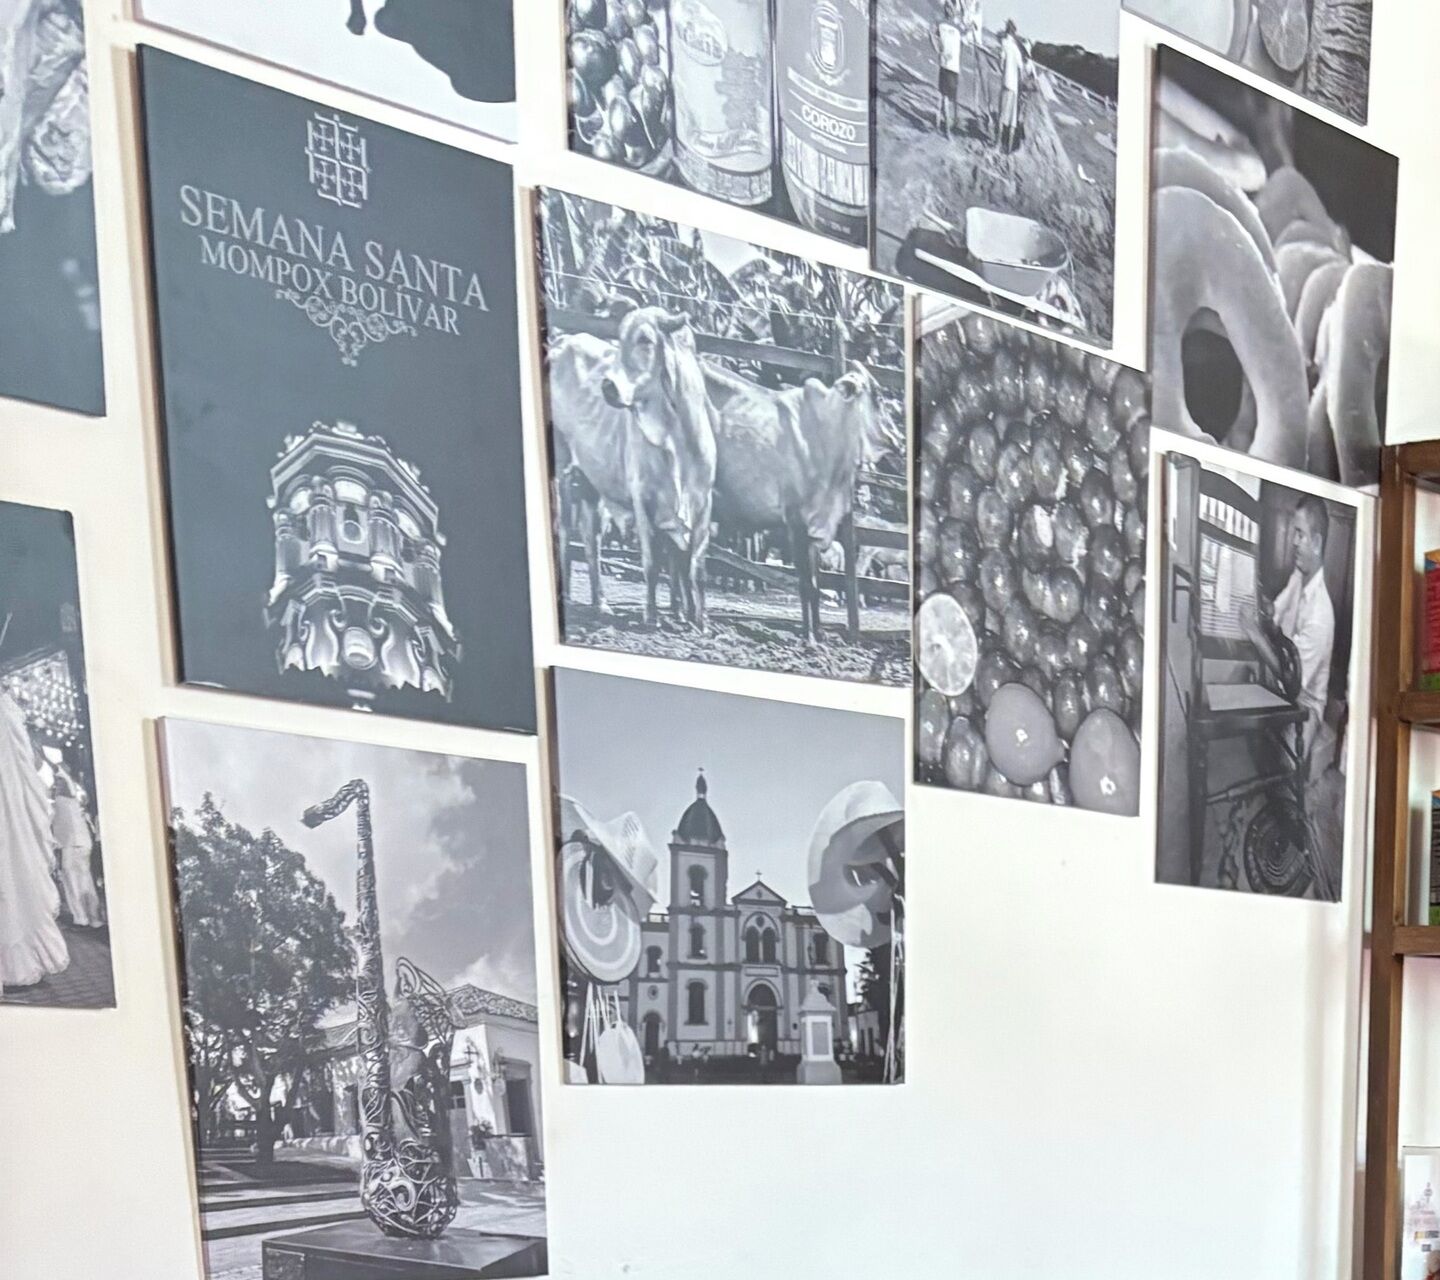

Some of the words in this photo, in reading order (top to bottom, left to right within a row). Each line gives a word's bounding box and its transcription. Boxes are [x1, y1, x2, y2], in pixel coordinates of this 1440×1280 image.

[801, 104, 856, 141] COROZO
[180, 184, 355, 272] SEMANA
[364, 240, 490, 312] SANTA
[199, 235, 334, 299] MOMPOX
[338, 275, 460, 336] BOLÍVAR
